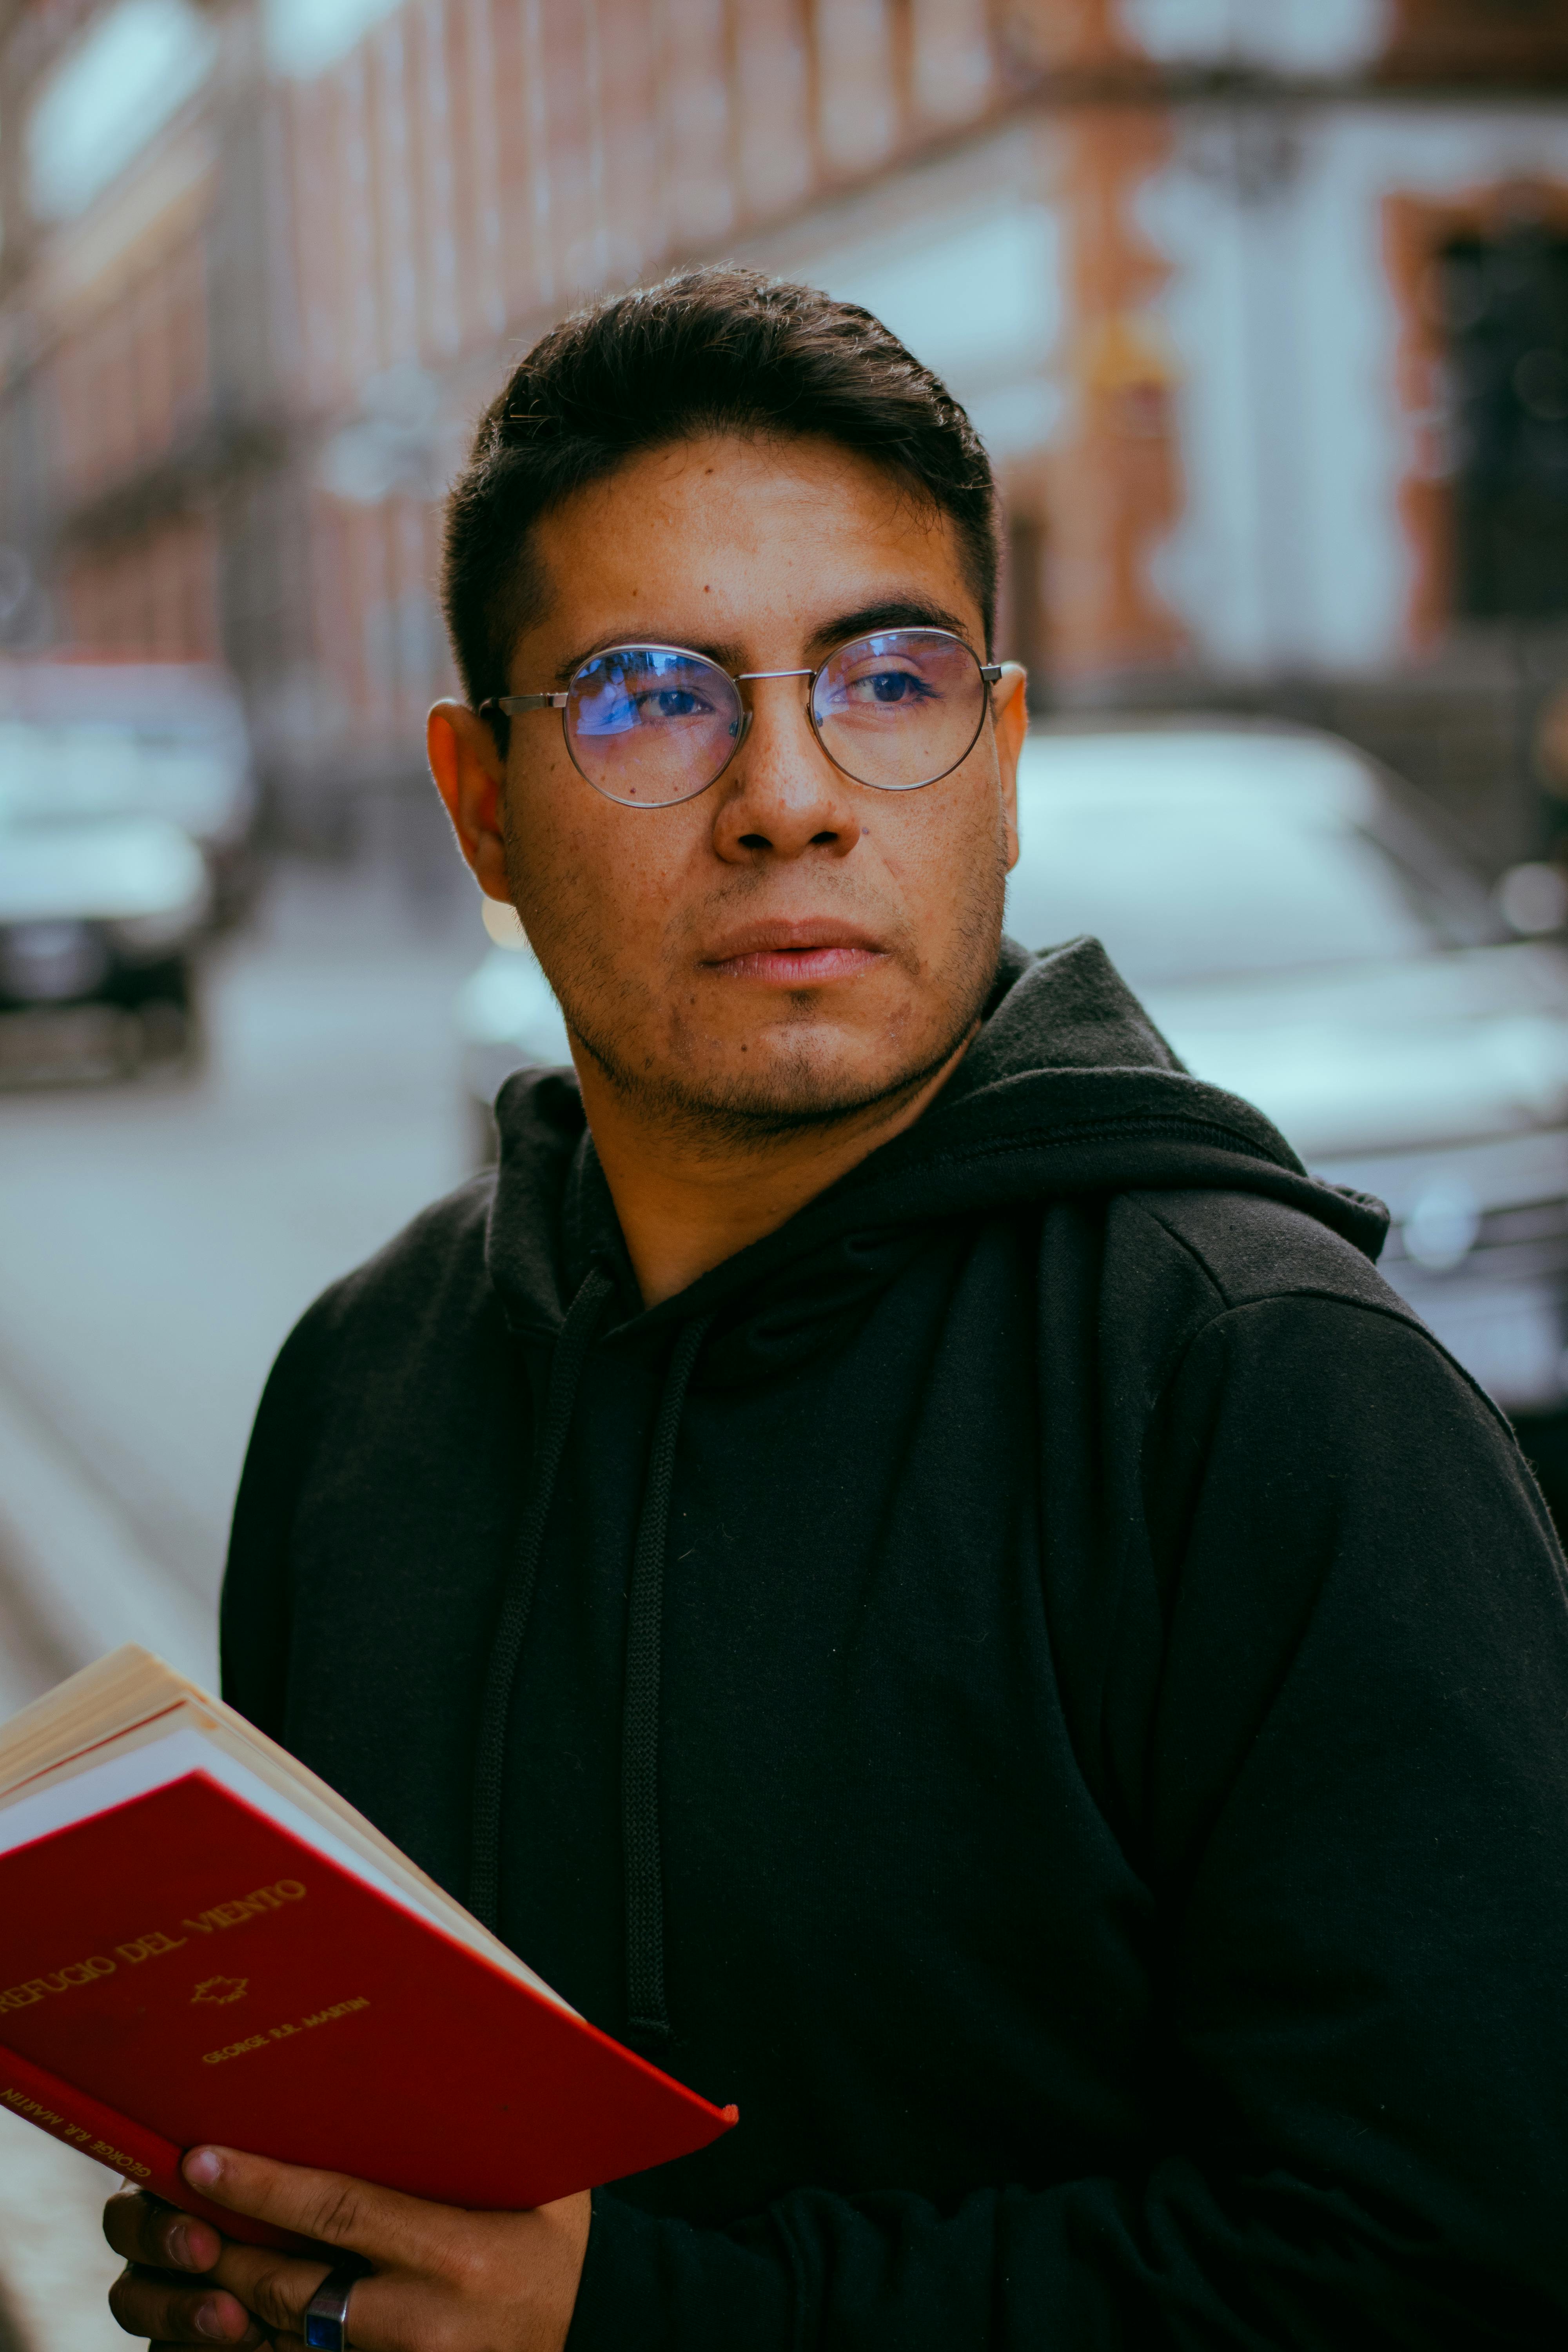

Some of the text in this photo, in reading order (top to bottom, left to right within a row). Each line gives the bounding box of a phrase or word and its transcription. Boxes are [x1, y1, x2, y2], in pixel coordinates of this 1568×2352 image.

[114, 1931, 188, 1964] DEL
[181, 1880, 307, 1933] VIENTO
[202, 2034, 270, 2064] GEORGE
[301, 1996, 370, 2027] MARTIN
[0, 2088, 151, 2176] GEORGE R.R. MARTIN
